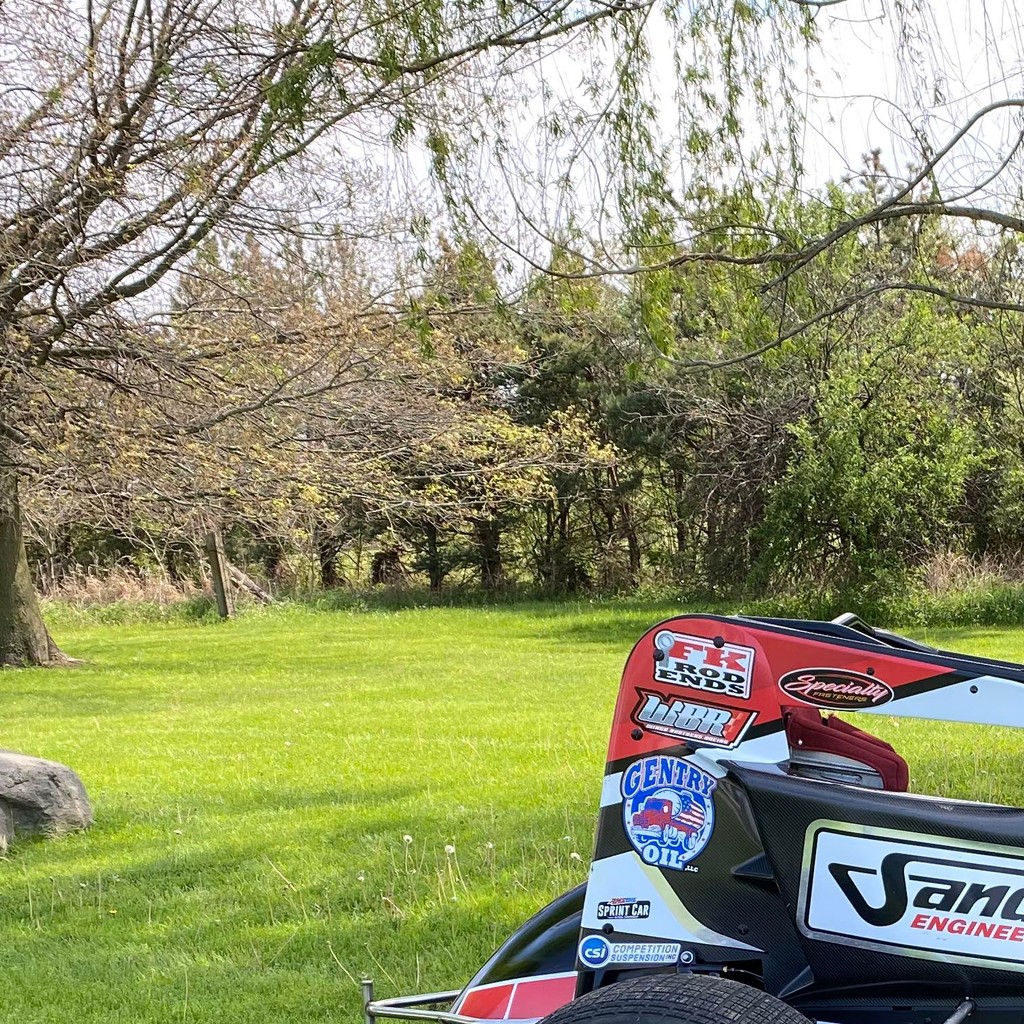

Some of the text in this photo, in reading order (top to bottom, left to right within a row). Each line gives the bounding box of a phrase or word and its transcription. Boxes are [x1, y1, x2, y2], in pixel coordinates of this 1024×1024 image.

[668, 640, 747, 673] FK
[657, 668, 745, 695] ENDS
[674, 661, 746, 684] ROD
[784, 674, 889, 704] Specialty
[812, 691, 868, 703] FASTENERS
[623, 757, 716, 797] GENTRY
[642, 844, 683, 869] OIL
[598, 903, 650, 917] SPRINT CAR
[585, 944, 607, 959] csi
[611, 953, 666, 962] SUSPENSION
[613, 944, 679, 954] COMPETITION
